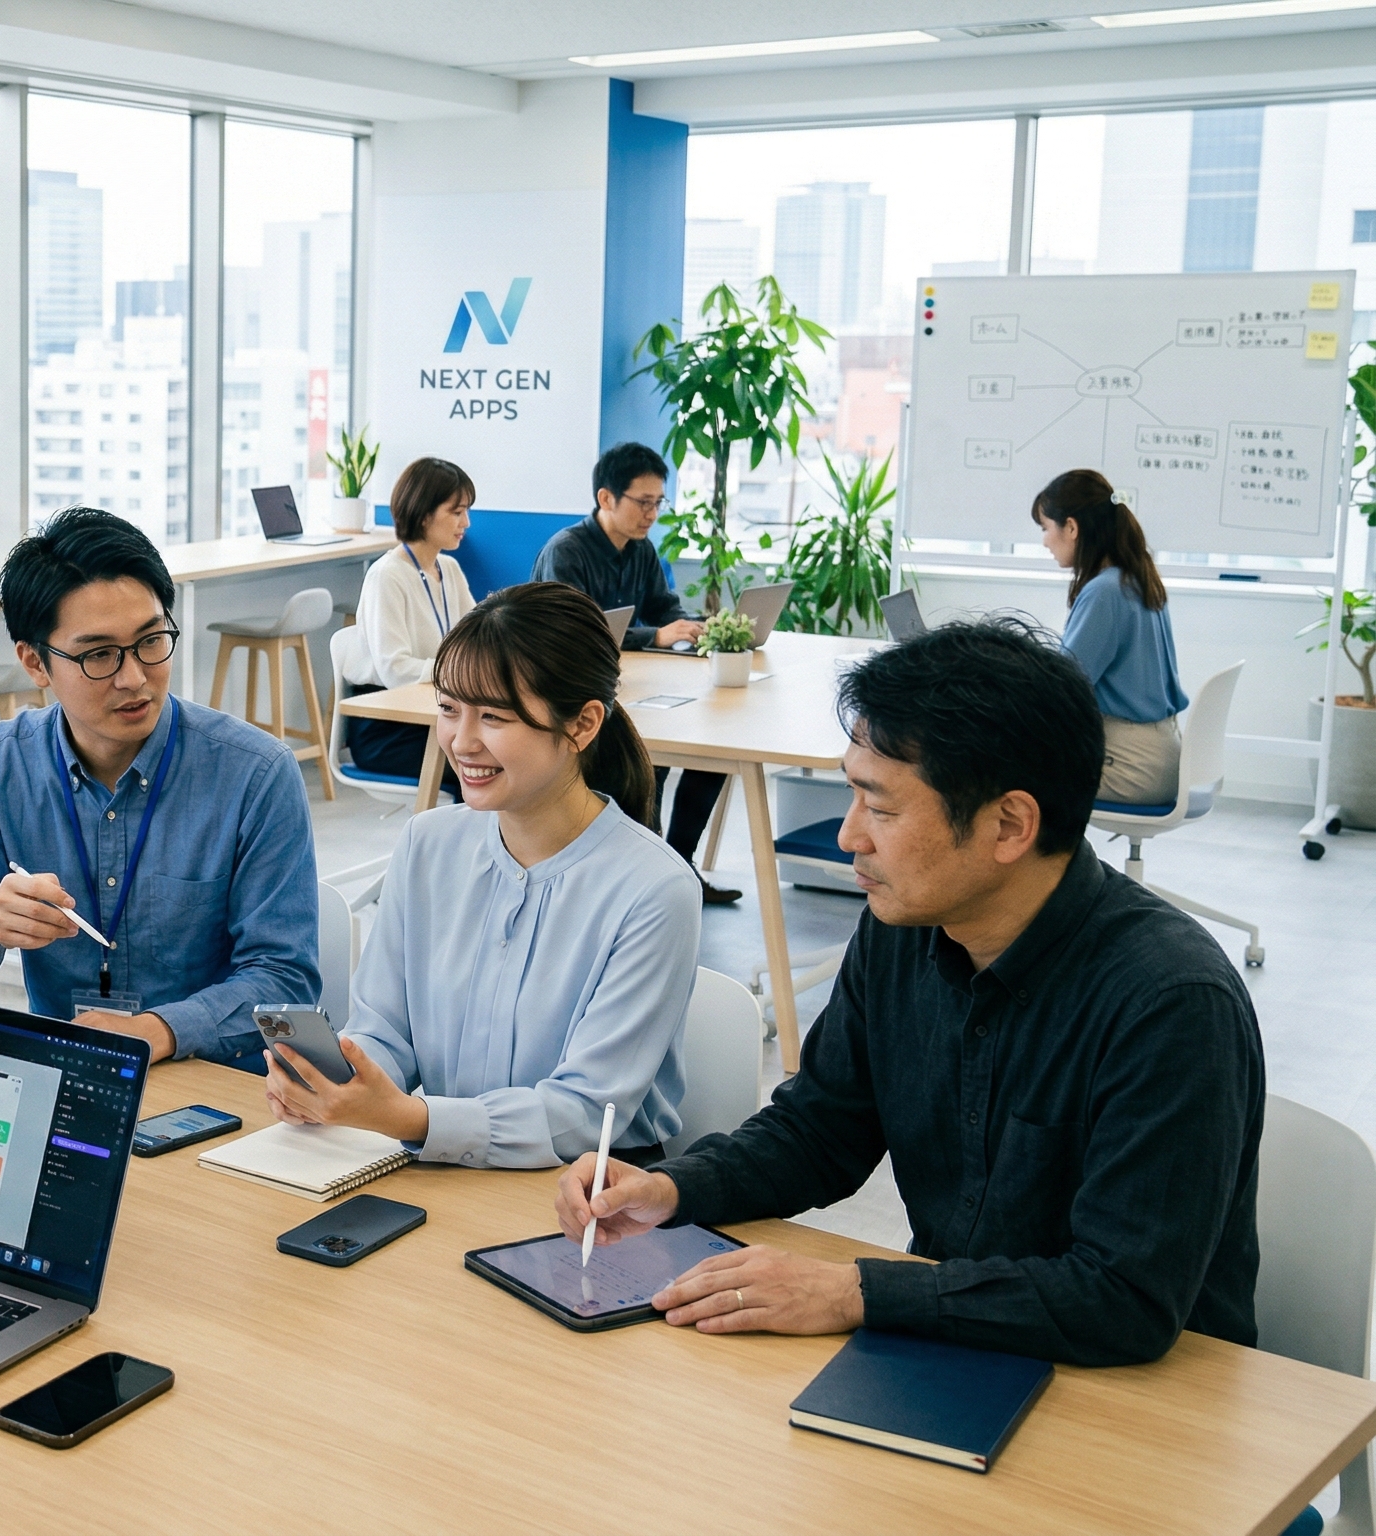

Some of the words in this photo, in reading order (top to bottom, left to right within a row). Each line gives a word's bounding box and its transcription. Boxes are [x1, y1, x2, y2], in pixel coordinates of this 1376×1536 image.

[420, 369, 487, 389] NEXT
[495, 369, 551, 390] GEN
[449, 399, 518, 421] APPS
